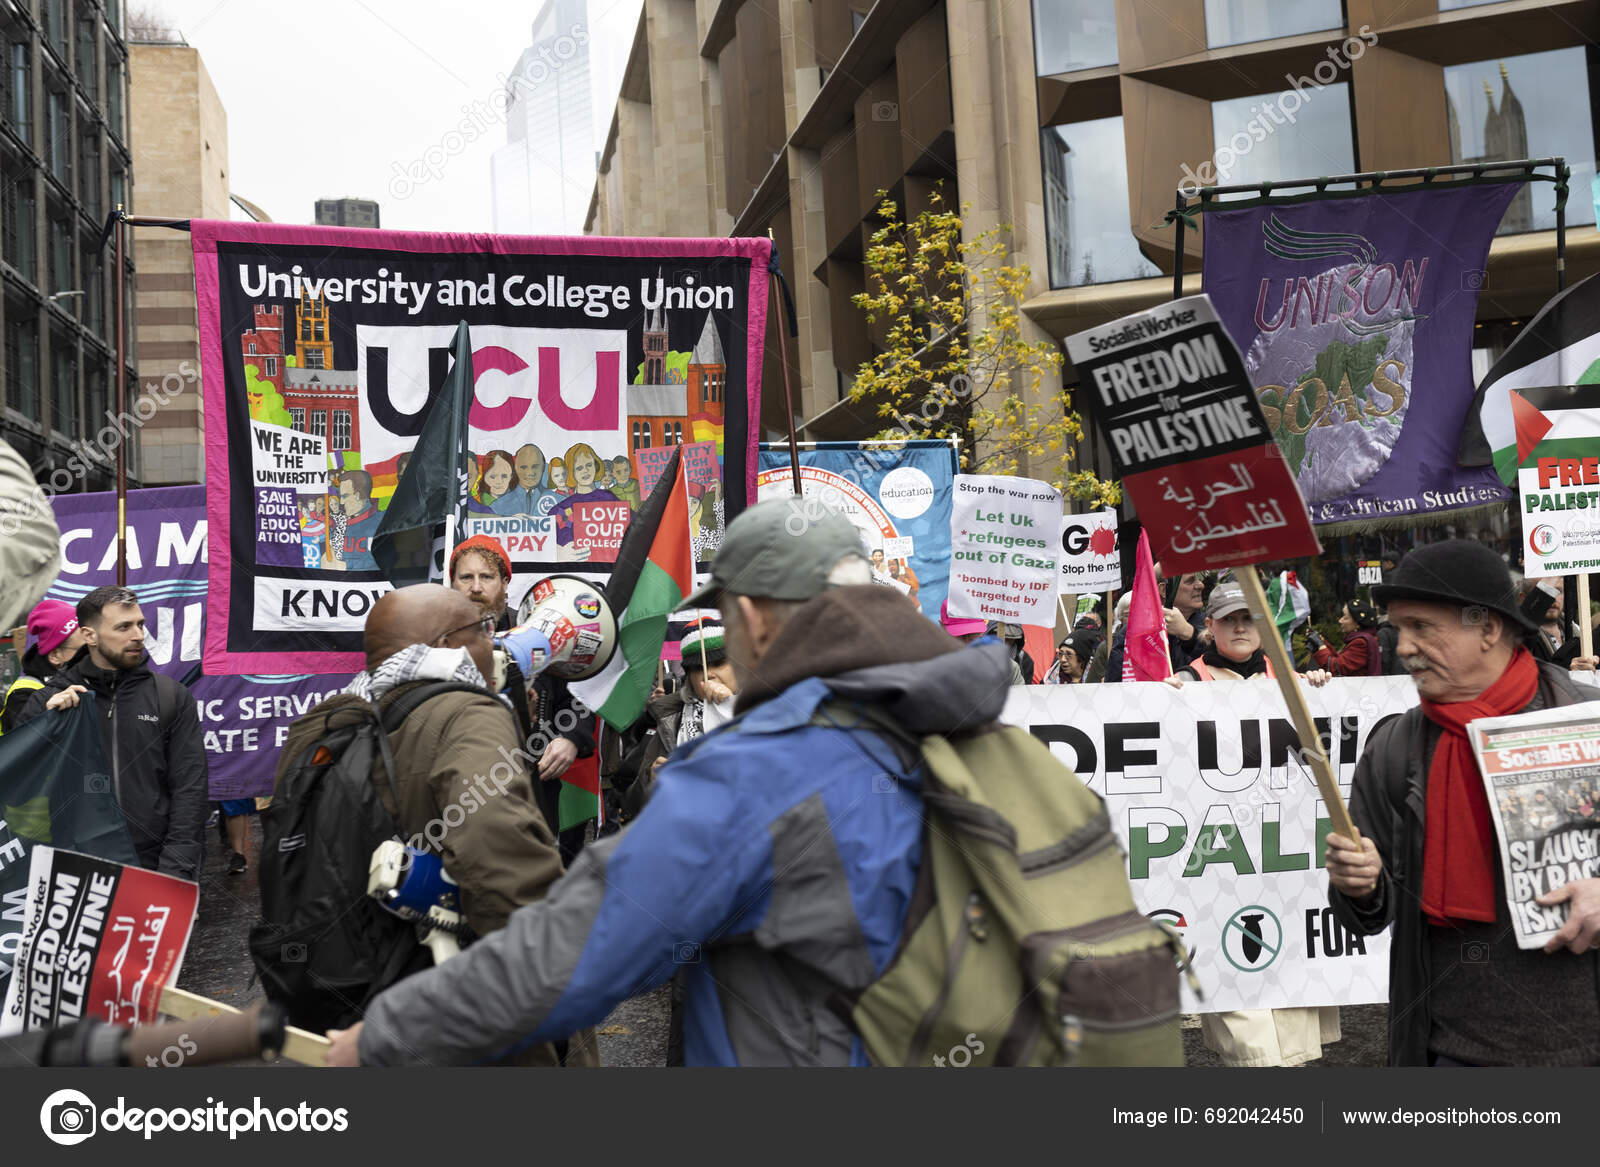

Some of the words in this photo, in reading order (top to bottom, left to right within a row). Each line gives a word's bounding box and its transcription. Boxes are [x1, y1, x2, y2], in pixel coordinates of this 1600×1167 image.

[239, 263, 431, 315] University
[436, 273, 496, 306] and
[502, 275, 630, 318] College
[641, 276, 734, 309] Union
[1255, 257, 1429, 332] UNISON
[1088, 323, 1146, 353] Socialist
[1143, 308, 1197, 336] Worker
[1092, 334, 1228, 406] FREEDOM
[366, 345, 620, 437] UCU
[1159, 393, 1180, 411] for
[1109, 395, 1262, 466] PALESTINE
[254, 427, 283, 453] WE
[288, 436, 322, 456] ARE
[273, 453, 303, 469] THE
[640, 445, 712, 464] EQULITY
[256, 471, 327, 485] UNIVERSITY
[1537, 456, 1600, 490] FRE
[959, 483, 984, 495] Stop
[988, 486, 1005, 495] the
[1009, 490, 1030, 500] war
[1032, 494, 1055, 502] now
[1158, 463, 1254, 510] الحرية
[259, 490, 293, 505] SAVE
[1341, 496, 1417, 516] African
[1423, 486, 1502, 507] Studies
[1525, 491, 1600, 513] PALEST
[257, 504, 297, 517] ADULT
[581, 507, 628, 522] LOVE
[975, 510, 1004, 524] Let
[1010, 513, 1035, 527] Uk
[260, 518, 299, 530] EDUC-
[473, 518, 551, 534] FUNDING
[585, 523, 625, 538] OUR
[1170, 498, 1288, 554] لفلسطين
[258, 531, 301, 544] ATION
[507, 535, 547, 552] PAY
[955, 551, 983, 561] out
[989, 552, 1006, 564] of
[1011, 553, 1055, 570] Gaza
[1062, 564, 1085, 575] Stop
[1087, 563, 1104, 573] the
[1011, 577, 1026, 591] by
[1029, 578, 1050, 591] IDF
[1358, 566, 1382, 584] GAZA
[1023, 591, 1038, 606] by
[980, 604, 1020, 617] Hamas
[1497, 742, 1581, 769] Socialist
[1512, 868, 1545, 903] BY
[11, 941, 30, 1017] Socialist
[25, 876, 47, 940] Worker
[54, 944, 71, 975] for
